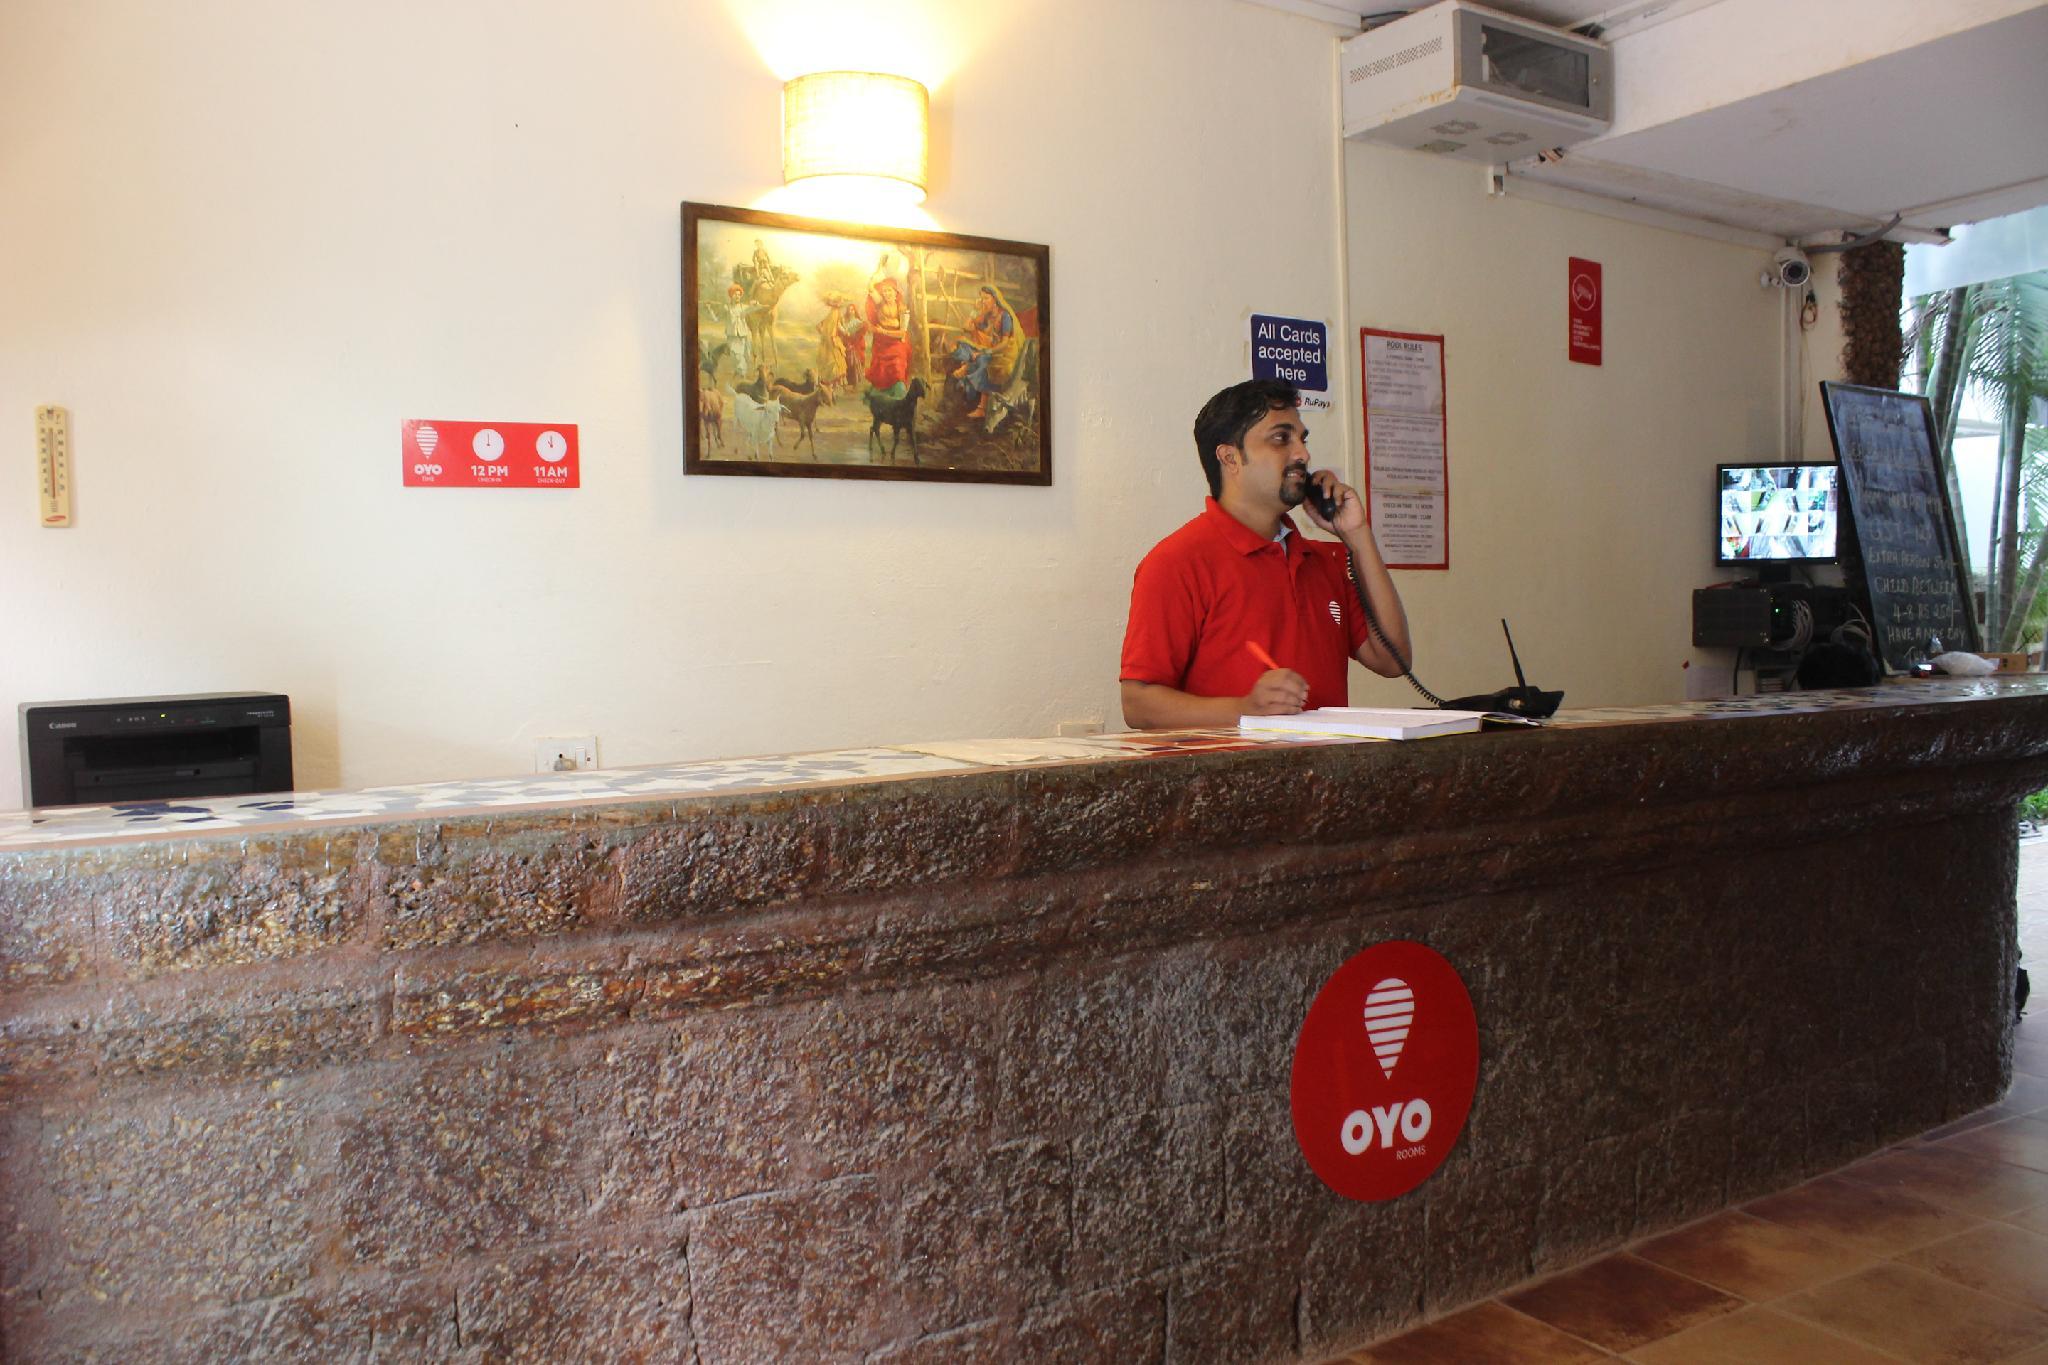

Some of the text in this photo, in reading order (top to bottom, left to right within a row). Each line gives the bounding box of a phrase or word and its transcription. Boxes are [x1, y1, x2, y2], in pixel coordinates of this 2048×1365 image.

[1257, 322, 1320, 345] All Cards
[1258, 345, 1320, 365] accepted
[1275, 363, 1307, 381] here
[414, 463, 443, 475] OYO
[470, 465, 508, 477] 12 PM
[48, 721, 77, 730] Canon
[1340, 1098, 1432, 1156] OYO
[1396, 1145, 1426, 1160] ROOMS
